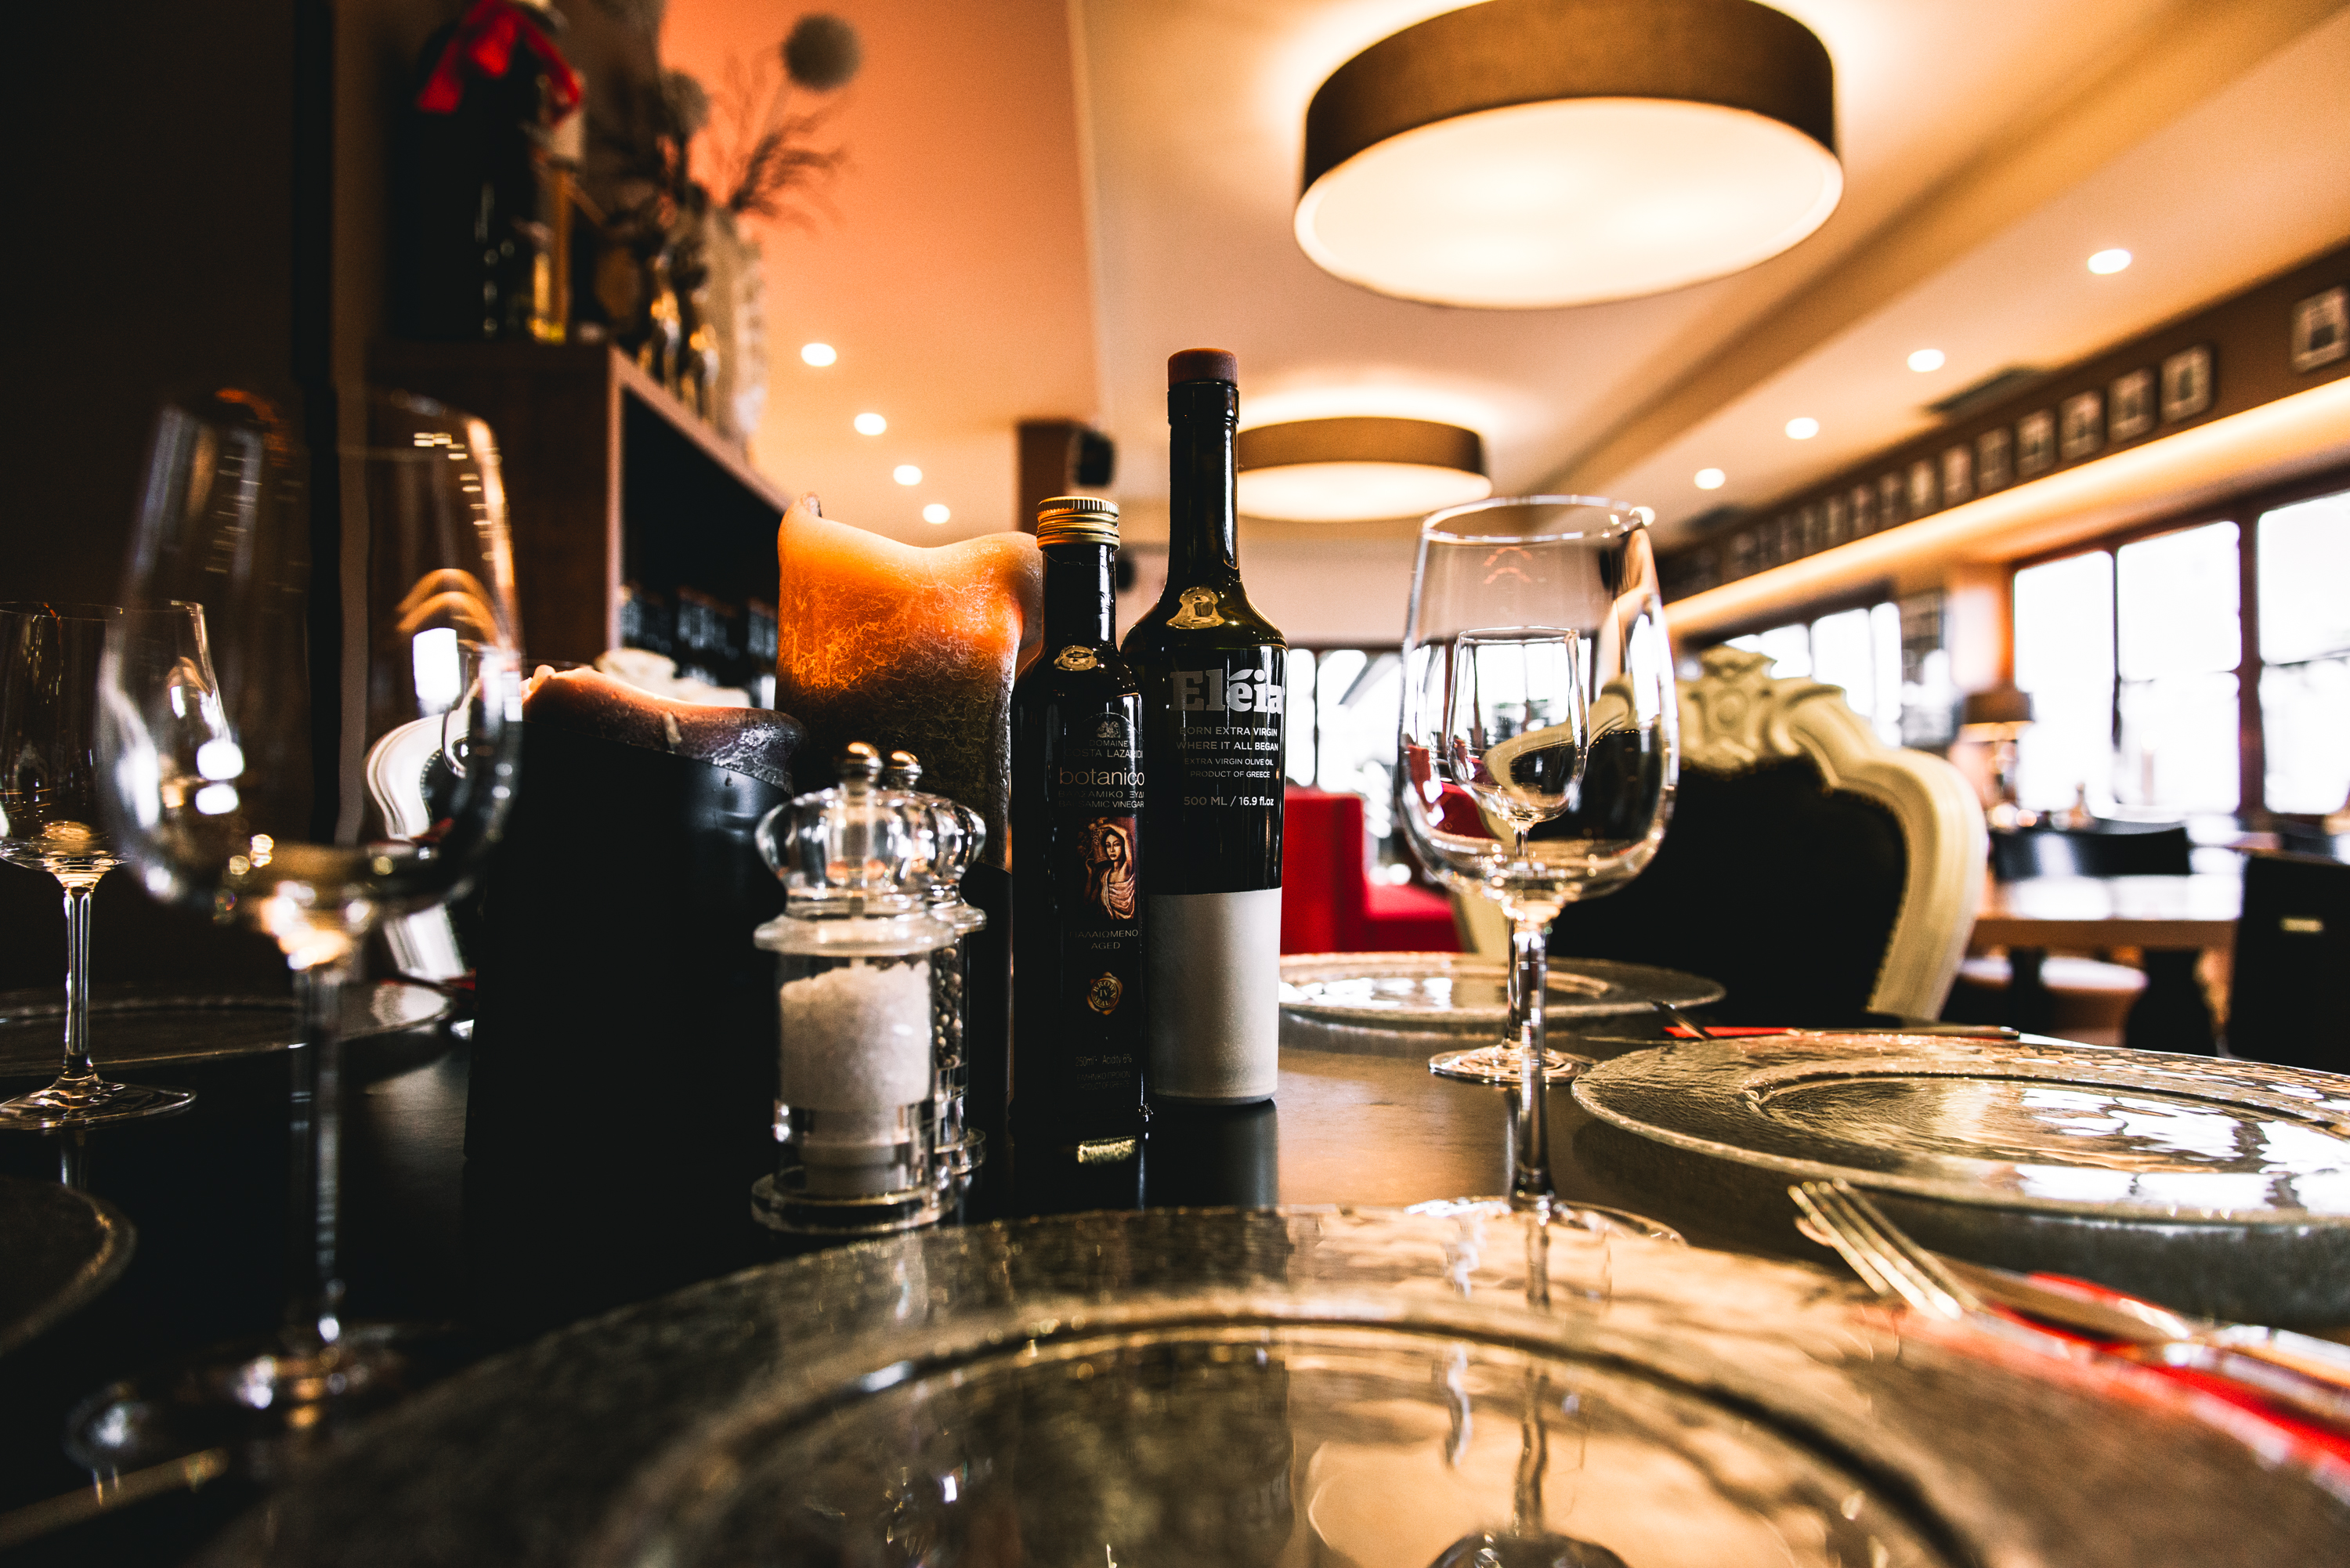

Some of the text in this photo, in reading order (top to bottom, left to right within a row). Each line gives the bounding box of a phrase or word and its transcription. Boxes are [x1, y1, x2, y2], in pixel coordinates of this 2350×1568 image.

[1170, 668, 1283, 714] Eléia
[1179, 726, 1278, 737] BORN EXTRA VIRGIN
[1089, 739, 1128, 748] DOMAINE
[1177, 741, 1279, 752] WHERE IT ALL BEGAN
[1064, 749, 1102, 757] COSTA
[1059, 766, 1145, 786] botanico
[1184, 795, 1274, 807] 500 ML / 16.9 fl.oz
[1093, 980, 1116, 999] BROWN
[1099, 988, 1109, 998] IV
[1093, 995, 1111, 1006] SEAL
